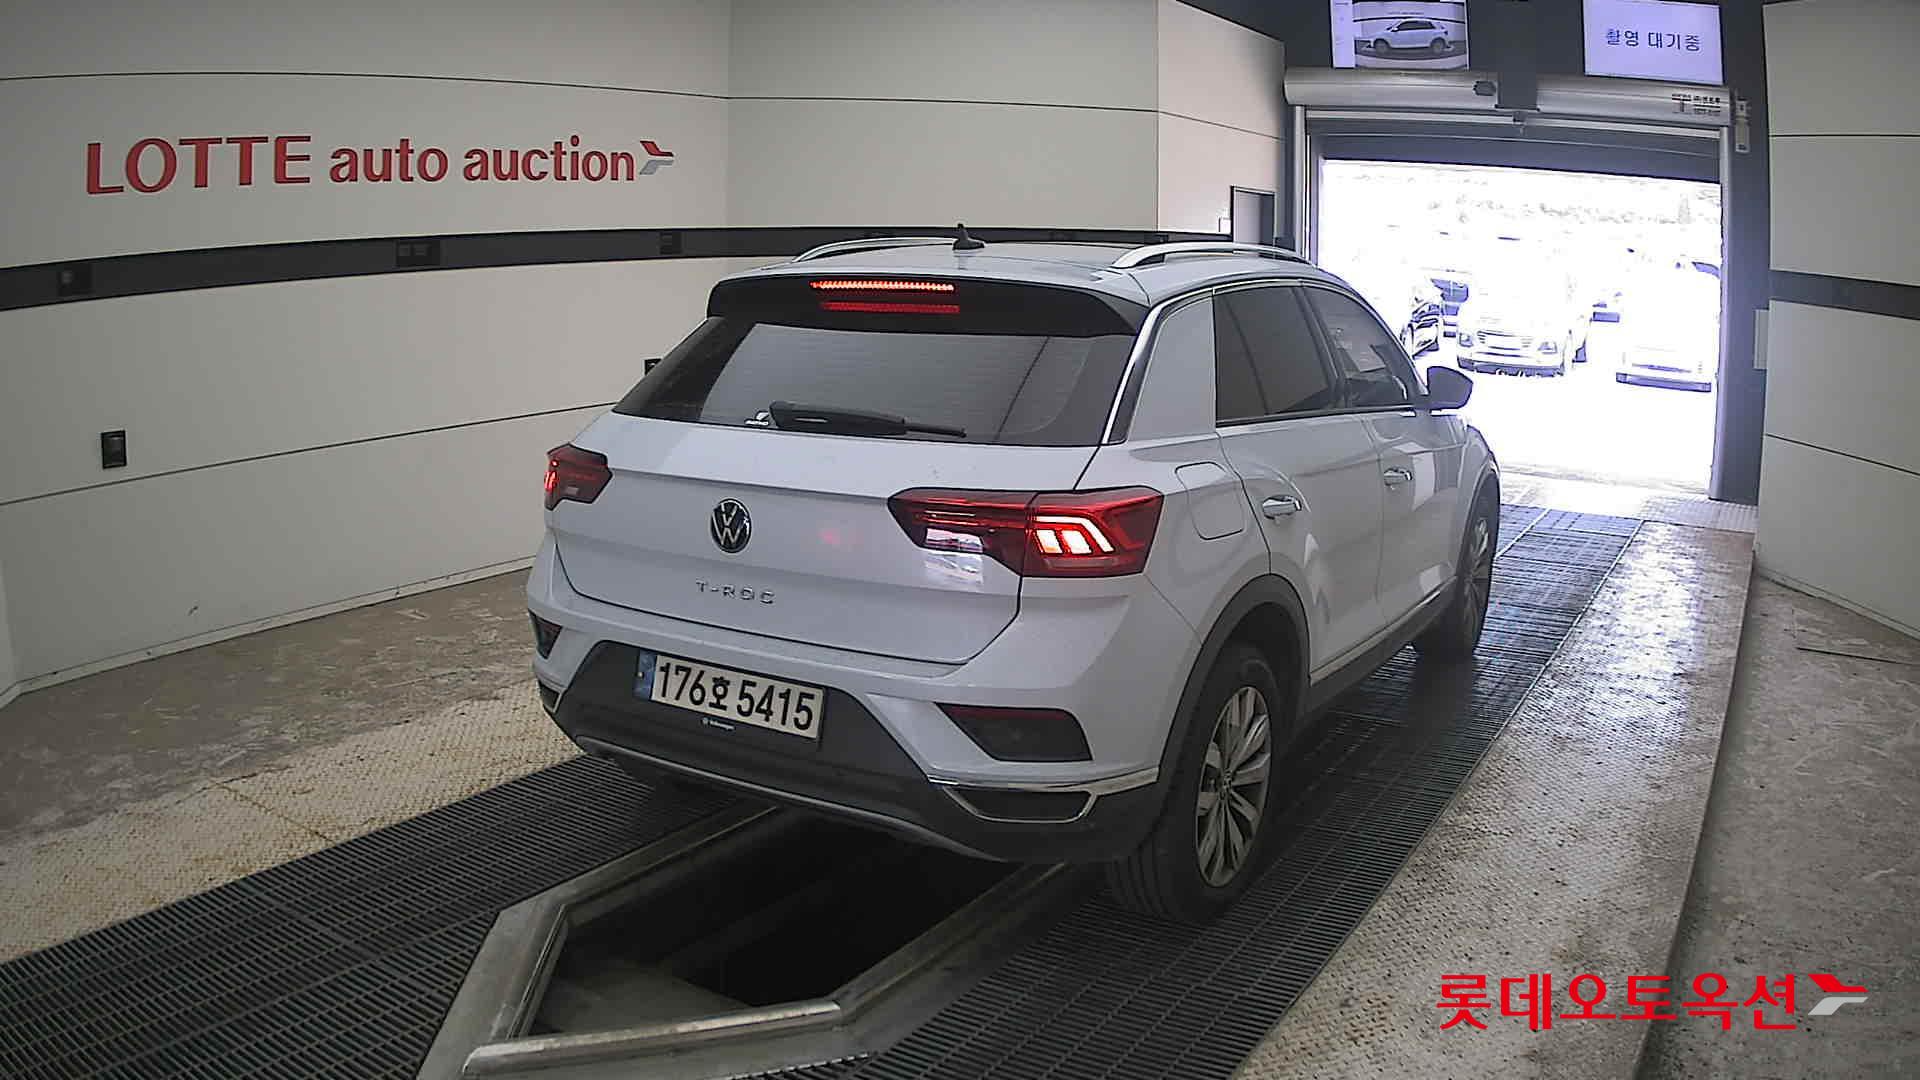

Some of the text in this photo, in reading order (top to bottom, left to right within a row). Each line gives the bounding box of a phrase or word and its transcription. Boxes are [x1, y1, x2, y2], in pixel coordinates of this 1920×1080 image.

[1606, 28, 1700, 52] 촬영 대기중
[86, 134, 635, 195] LOTTE auto auction
[696, 580, 775, 605] T-ROC
[659, 662, 815, 730] 176호 5415
